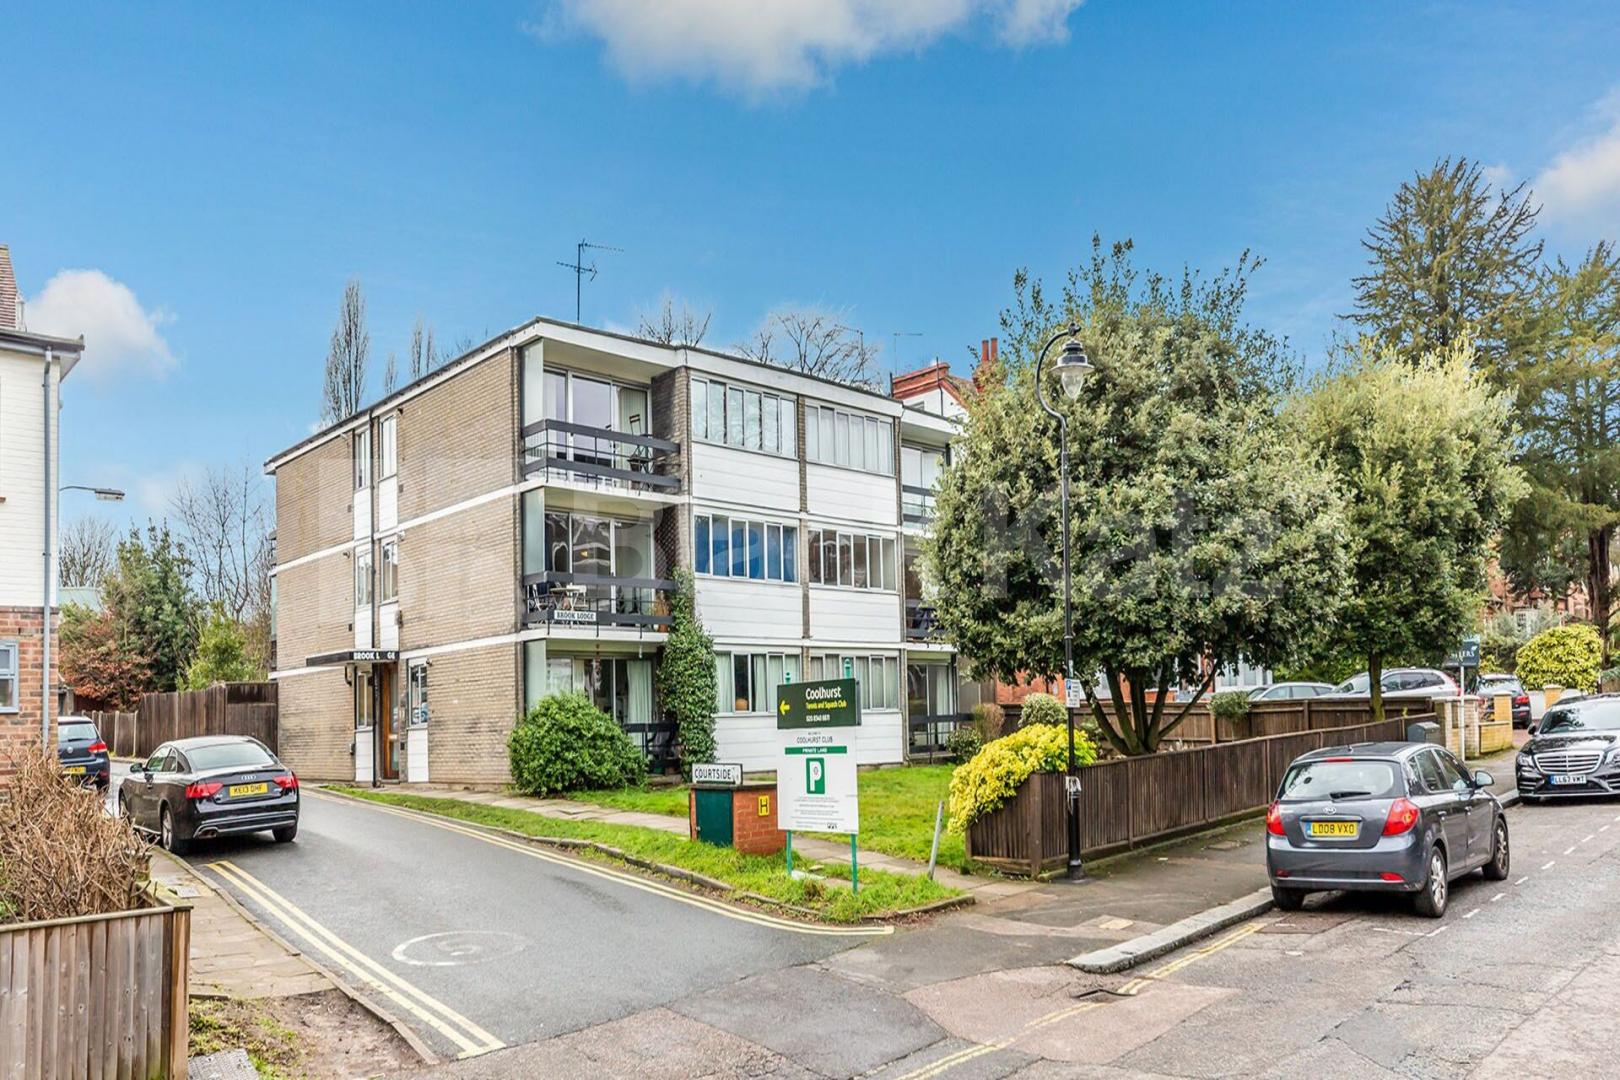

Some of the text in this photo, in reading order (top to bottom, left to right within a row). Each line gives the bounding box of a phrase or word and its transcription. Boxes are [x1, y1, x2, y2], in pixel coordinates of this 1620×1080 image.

[556, 611, 595, 620] BROOK LODGE
[353, 651, 375, 660] BROOK
[806, 686, 841, 700] Coolhurst
[825, 700, 838, 709] Squash
[838, 700, 847, 708] Club
[796, 736, 821, 744] COOLHURST
[694, 767, 731, 780] COURTSIDE
[809, 761, 822, 791] P
[760, 798, 769, 814] H
[1312, 824, 1335, 834] LD08
